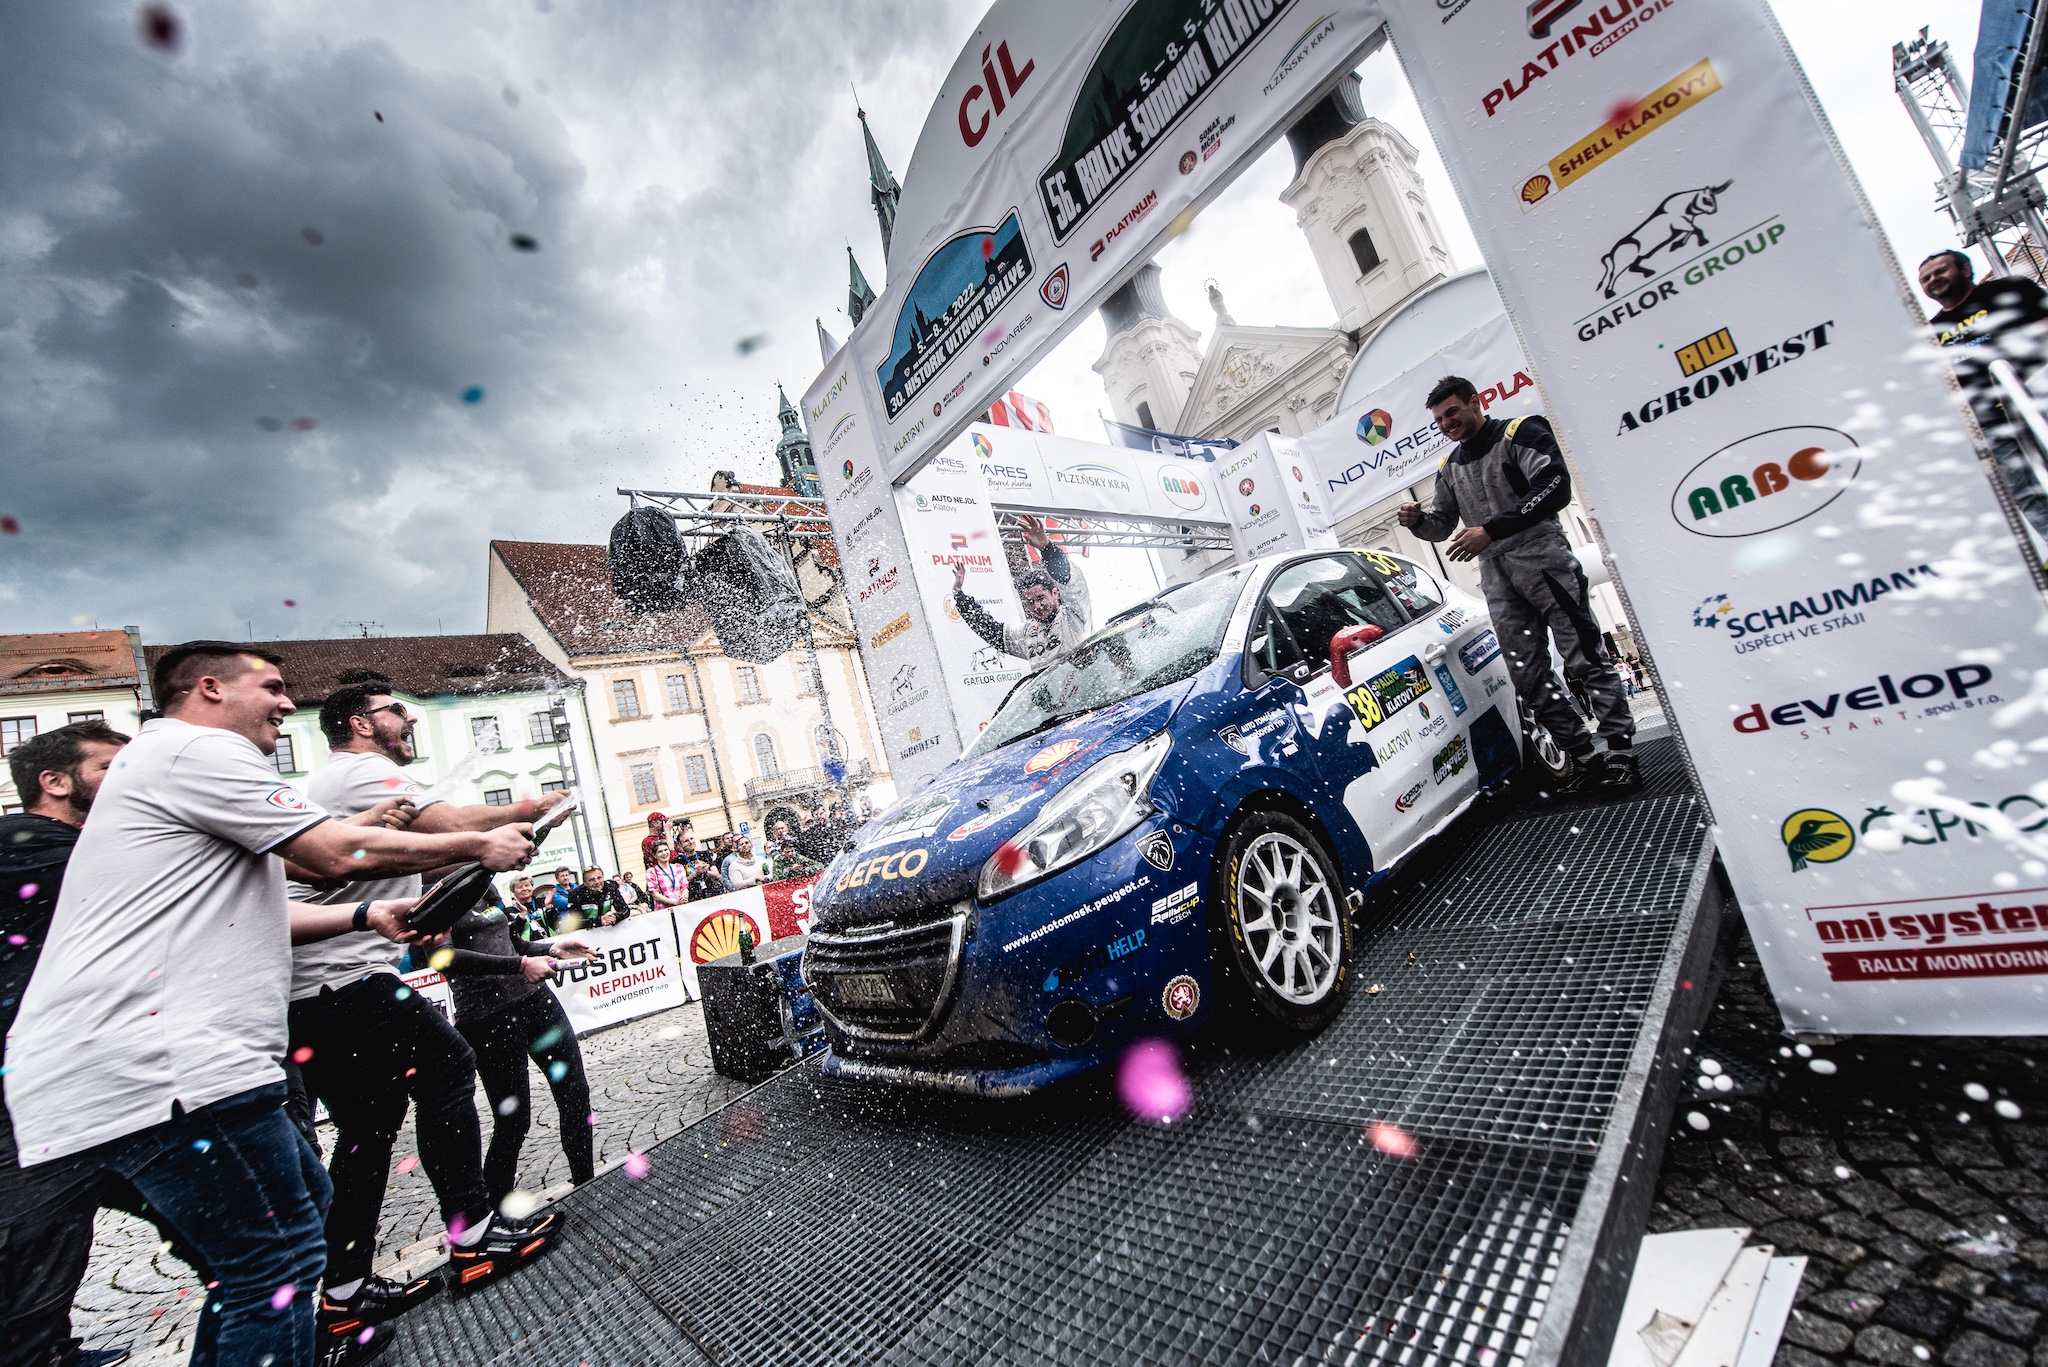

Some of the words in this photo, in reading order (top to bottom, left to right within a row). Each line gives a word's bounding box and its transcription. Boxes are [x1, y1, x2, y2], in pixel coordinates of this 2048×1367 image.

[1442, 0, 1471, 25] ŠKOD
[1592, 20, 1635, 54] ORLEN
[1639, 0, 1674, 22] OIL
[1262, 46, 1309, 96] PLZEŇSKÝ
[1311, 22, 1335, 49] KRAJ
[958, 39, 1035, 148] CÍL
[1045, 170, 1081, 231] 56.
[1074, 121, 1137, 206] RALLYE
[1127, 40, 1211, 149] ŠUMAVA
[1203, 0, 1284, 69] KLAT
[1199, 116, 1221, 143] SONAX
[1201, 135, 1216, 153] MČR
[1219, 114, 1236, 135] Rally
[1559, 137, 1613, 177] SHELL
[1614, 72, 1708, 140] KLATOVY
[1106, 190, 1157, 243] PLATINUM
[951, 282, 976, 312] 2022
[1578, 281, 1679, 342] GAFLOR
[1684, 223, 1786, 286] GROUP
[889, 391, 906, 413] 30.
[905, 350, 947, 398] HISTORIC
[945, 307, 985, 354] VLTAVA
[985, 258, 1026, 315] RALLYE
[990, 313, 1033, 360] NOVARES
[812, 371, 848, 422] KLATOVY
[1478, 367, 1534, 410] PLA
[1617, 320, 1834, 437] AGROWEST
[822, 430, 843, 458] PLZEŇSKÝ
[842, 419, 856, 436] KRAJ
[892, 417, 925, 455] KLATOVY
[1219, 451, 1259, 480] KLATOVY
[1328, 421, 1441, 492] NOVARES
[1386, 453, 1421, 478] Beyond
[836, 466, 872, 505] NOVARES
[932, 495, 953, 503] AUTO
[954, 496, 977, 504] NEJDL
[1056, 471, 1106, 487] PLZEŇSKÝ
[1109, 478, 1131, 493] KRAJ
[1163, 476, 1200, 496] ARBO
[1688, 447, 1830, 520] ARBO
[933, 503, 957, 513] Klatovy
[1240, 508, 1278, 532] NOVARES
[932, 555, 992, 566] PLATINUM
[1256, 540, 1271, 550] AUTO
[860, 566, 898, 602] PLATINUM
[1734, 630, 1795, 655] ÚSPĚCH
[1797, 624, 1820, 638] VE
[1825, 612, 1866, 632] STÁJI
[963, 673, 996, 686] GAFLOR
[996, 672, 1022, 683] GROUP
[1386, 687, 1414, 714] KLATOVY
[1412, 677, 1430, 696] 2022
[1348, 687, 1381, 728] 38
[1733, 663, 1992, 734] develop
[1924, 703, 1961, 717] spol.
[1964, 699, 1975, 709] s
[1977, 694, 2005, 706] r.o.
[1241, 721, 1256, 733] AUTO
[1419, 715, 1445, 739] NOVARES
[900, 734, 941, 762] AGROWEST
[1377, 728, 1413, 764] KLATOVY
[544, 846, 576, 857] TEXTIL
[1138, 832, 1164, 847] PEUGEOT
[835, 849, 928, 892] GEFCO
[1002, 875, 1150, 953] www.autotomask.peugeot.cz
[1151, 881, 1198, 915] 208
[1170, 909, 1191, 925] CZECH
[589, 965, 667, 998] NEPOMUK
[1858, 957, 1919, 973] RALLY
